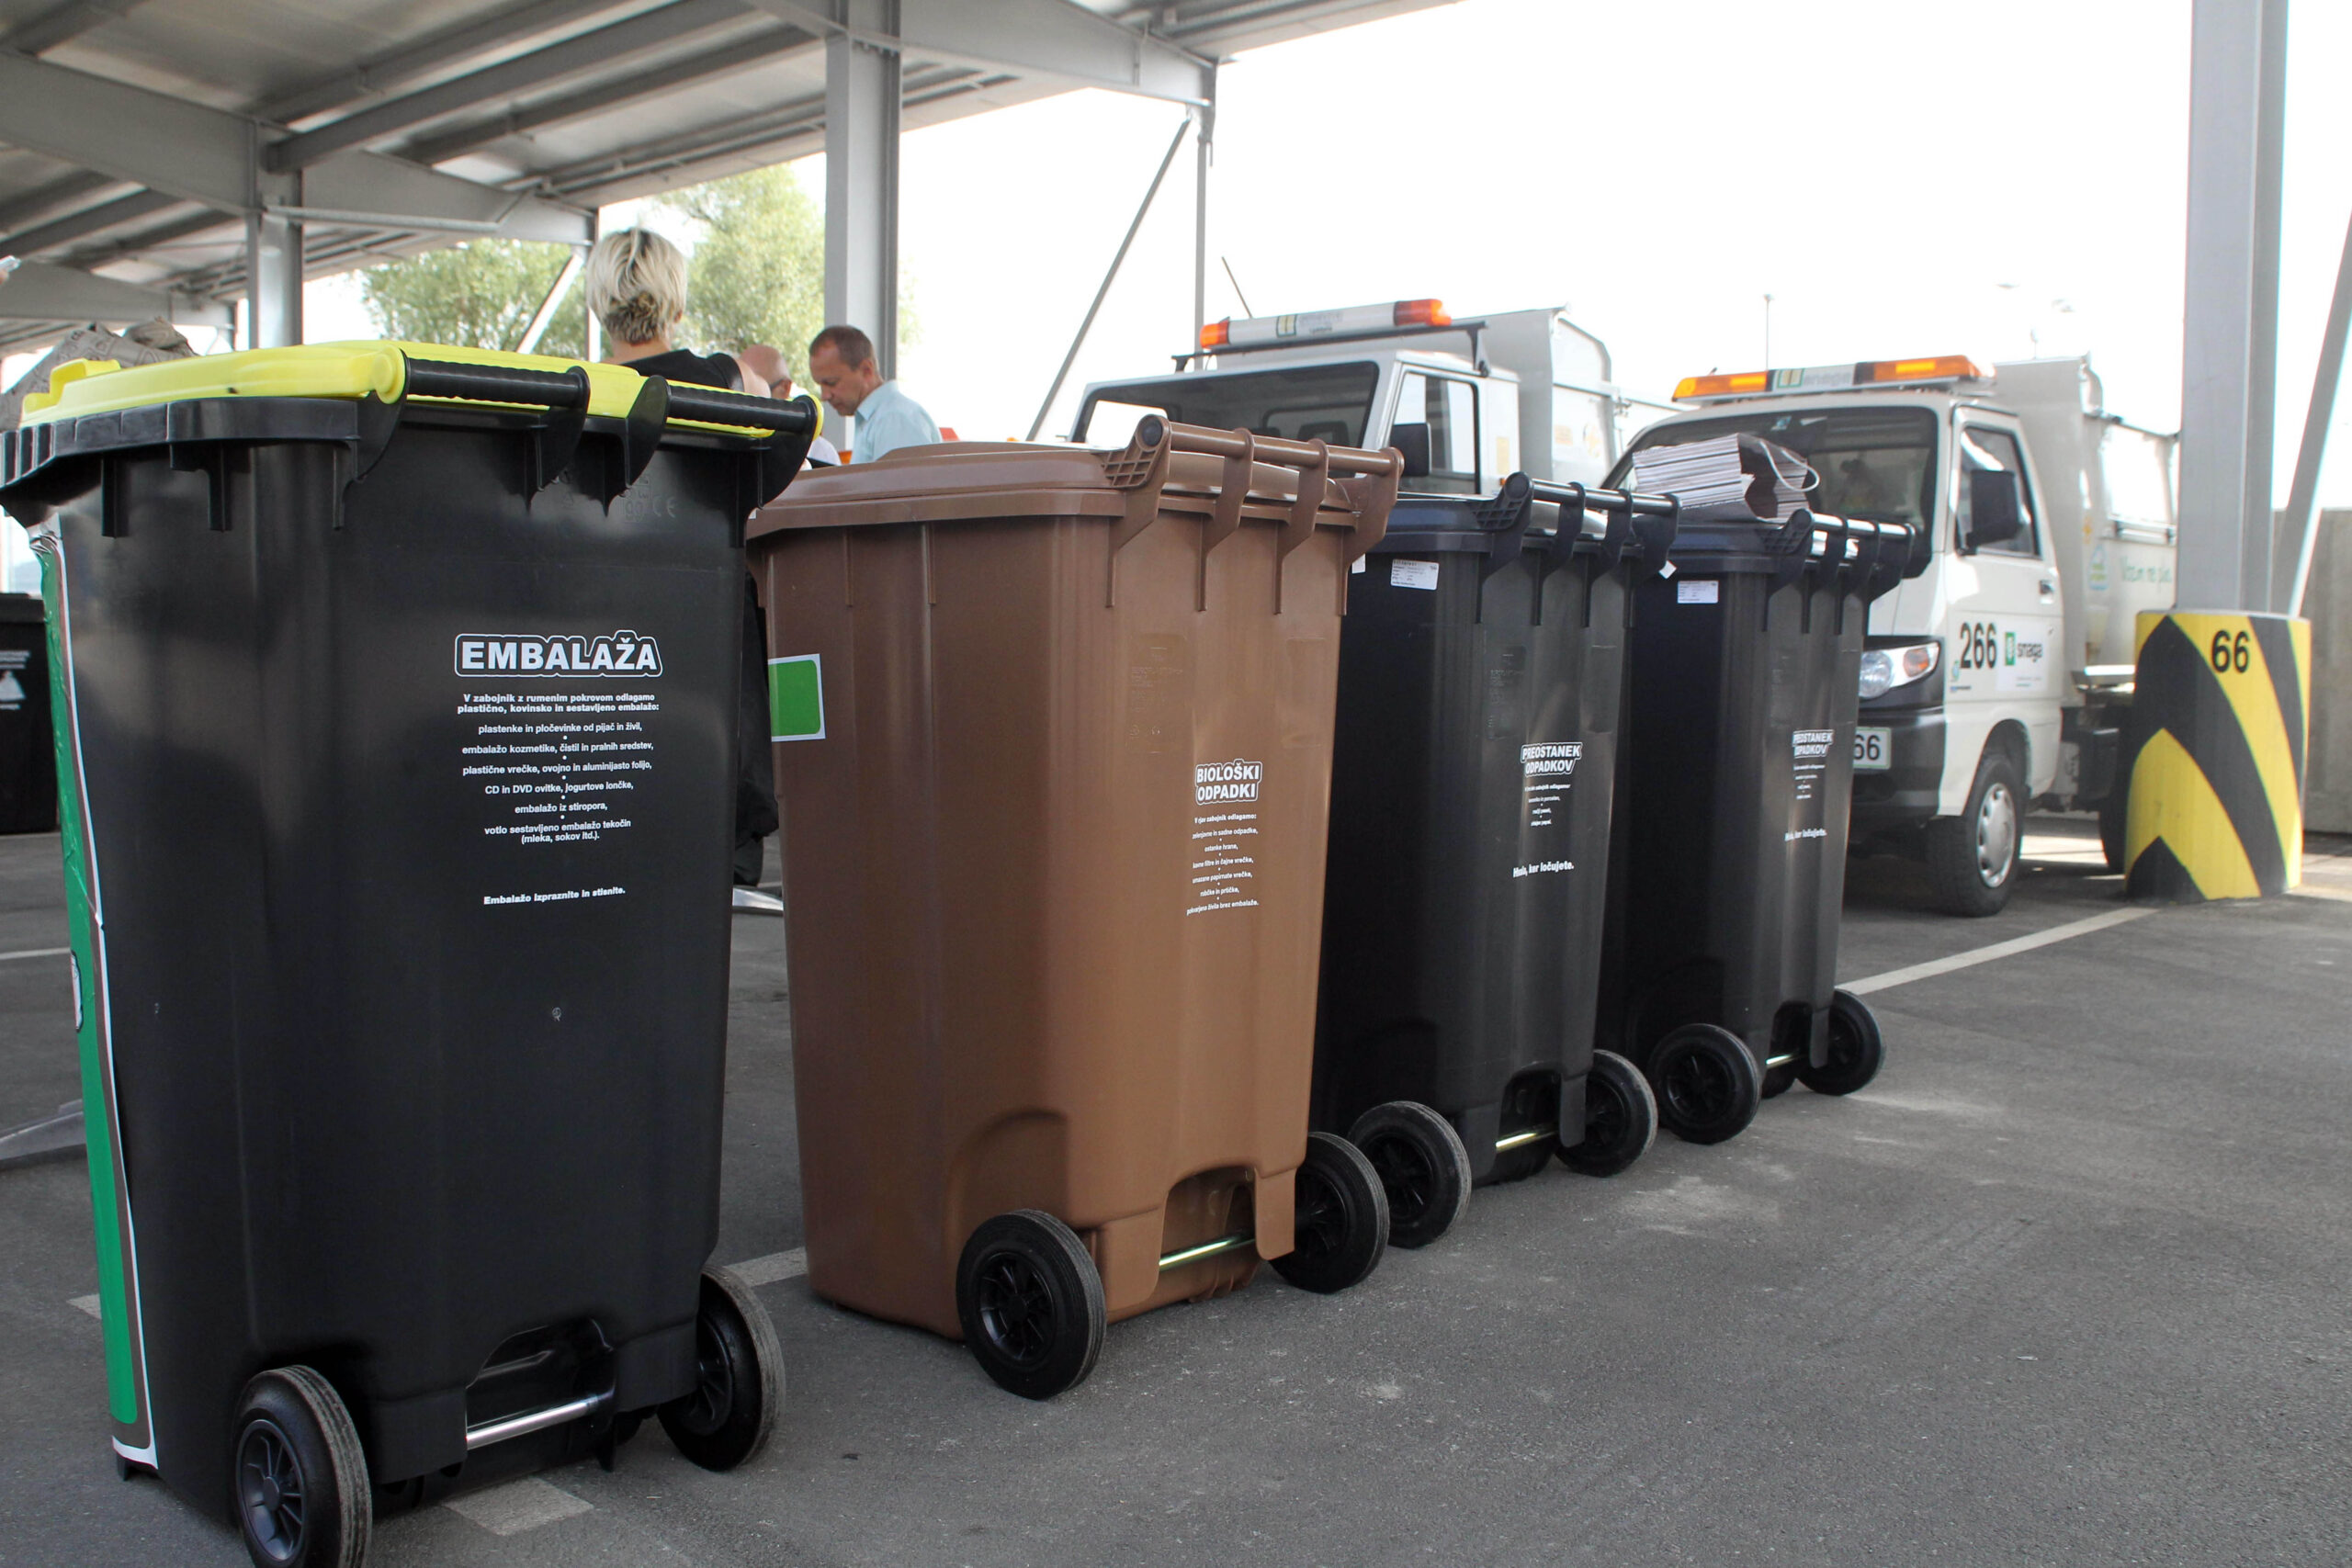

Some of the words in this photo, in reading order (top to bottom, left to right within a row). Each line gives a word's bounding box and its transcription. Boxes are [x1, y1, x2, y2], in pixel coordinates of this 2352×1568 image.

[1960, 622, 1997, 669] 266
[2211, 630, 2250, 673] 66
[462, 637, 658, 670] EMBALAŽA
[464, 694, 471, 702] V
[473, 694, 514, 704] zabojnik
[526, 694, 568, 702] rumenim
[571, 694, 613, 703] pokrovom
[616, 694, 654, 703] odlagamo
[458, 704, 507, 715] plastično,
[511, 704, 552, 712] kovinsko
[555, 704, 563, 712] in
[566, 704, 616, 713] sestavljeno
[618, 703, 659, 711] embalažo:
[479, 725, 523, 735] plastenke
[526, 724, 533, 733] in
[536, 723, 581, 734] pločevinke
[583, 723, 594, 731] od
[596, 722, 615, 733] pijač
[617, 723, 624, 731] in
[626, 721, 642, 731] živil,
[462, 744, 507, 754] embalažo
[510, 744, 558, 754] kozmetike,
[560, 743, 580, 752] čistil
[582, 743, 588, 751] in
[591, 742, 617, 752] pralnih
[620, 742, 653, 750] sredstev,
[1522, 745, 1580, 760] PREOSTANEK
[463, 765, 504, 776] plastične
[508, 764, 540, 774] vrečke,
[542, 763, 571, 773] ovojno
[573, 763, 581, 772] in
[582, 761, 629, 771] aluminijasto
[632, 761, 652, 770] folijo,
[1197, 762, 1260, 783] BIOLOŠKI
[1525, 760, 1573, 773] ODPADKOV
[485, 785, 500, 795] CD
[503, 784, 510, 794] in
[513, 784, 532, 793] DVD
[535, 784, 563, 794] ovitke,
[565, 783, 604, 793] jogurtove
[606, 781, 633, 791] lončke,
[1197, 783, 1255, 801] ODPADKI
[514, 803, 557, 813] embalažo
[569, 802, 607, 812] stiropora,
[484, 826, 507, 834] votlo
[510, 824, 559, 834] sestavljeno
[561, 821, 601, 831] embalažo
[603, 819, 631, 829] tekočin
[521, 834, 552, 845] (mleka,
[555, 832, 581, 841] sokov
[582, 831, 599, 840] itd.).
[1541, 861, 1574, 872] ločujete.
[484, 894, 531, 905] Embalažo
[535, 892, 579, 902] izpraznite
[593, 887, 626, 897] stisnite.
